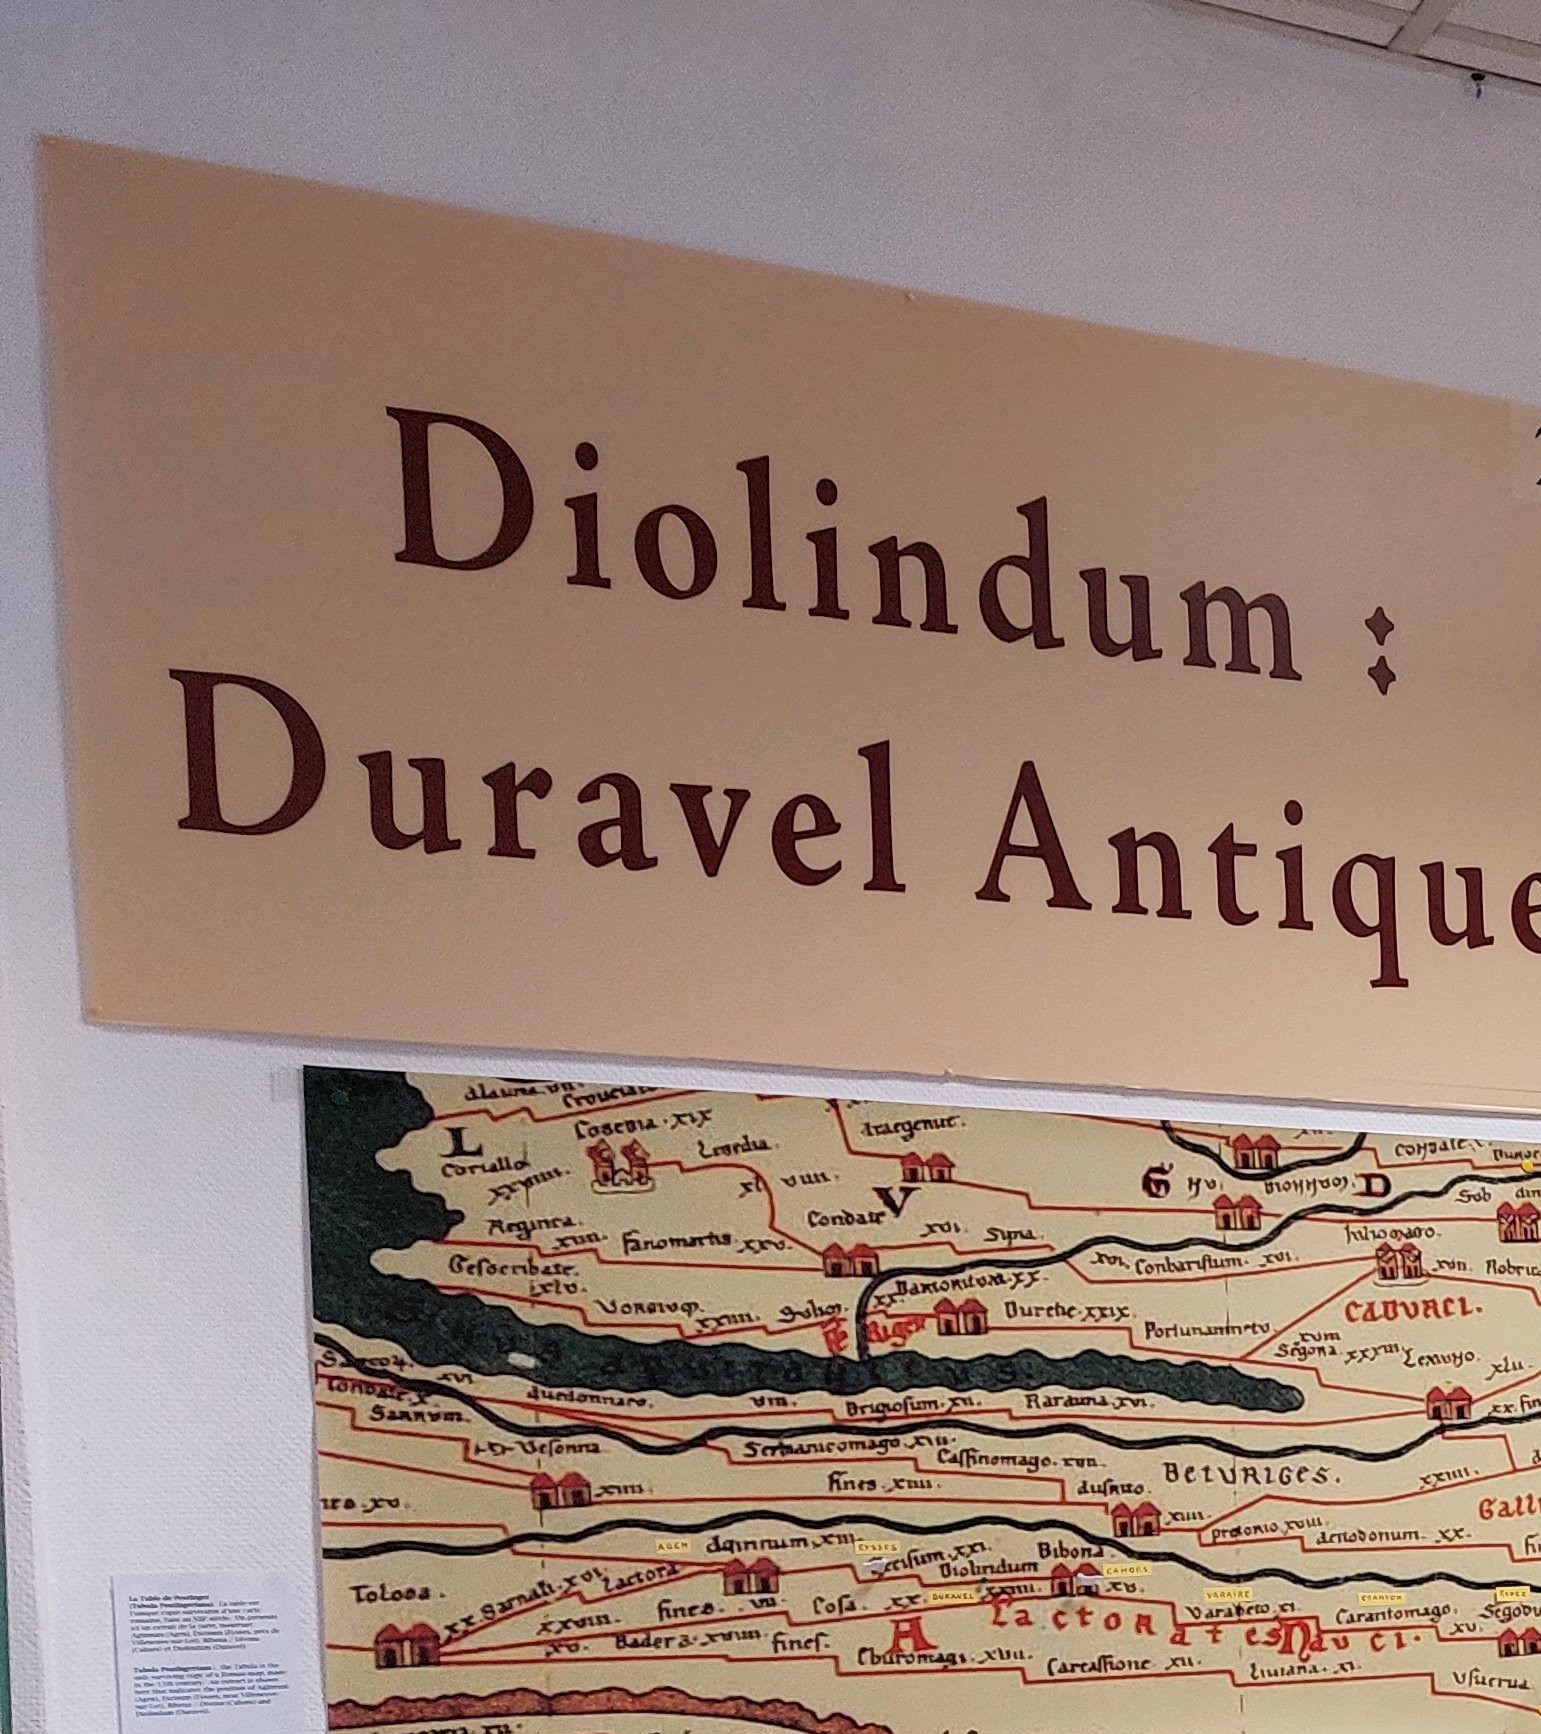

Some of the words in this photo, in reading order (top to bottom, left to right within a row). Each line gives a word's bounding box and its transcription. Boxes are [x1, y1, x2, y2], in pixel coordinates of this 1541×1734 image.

[384, 405, 1304, 684] Diolindum
[167, 667, 908, 897] Duravel
[441, 1127, 483, 1158] L
[873, 1187, 921, 1217] V
[932, 1592, 975, 1601] DURAVEL
